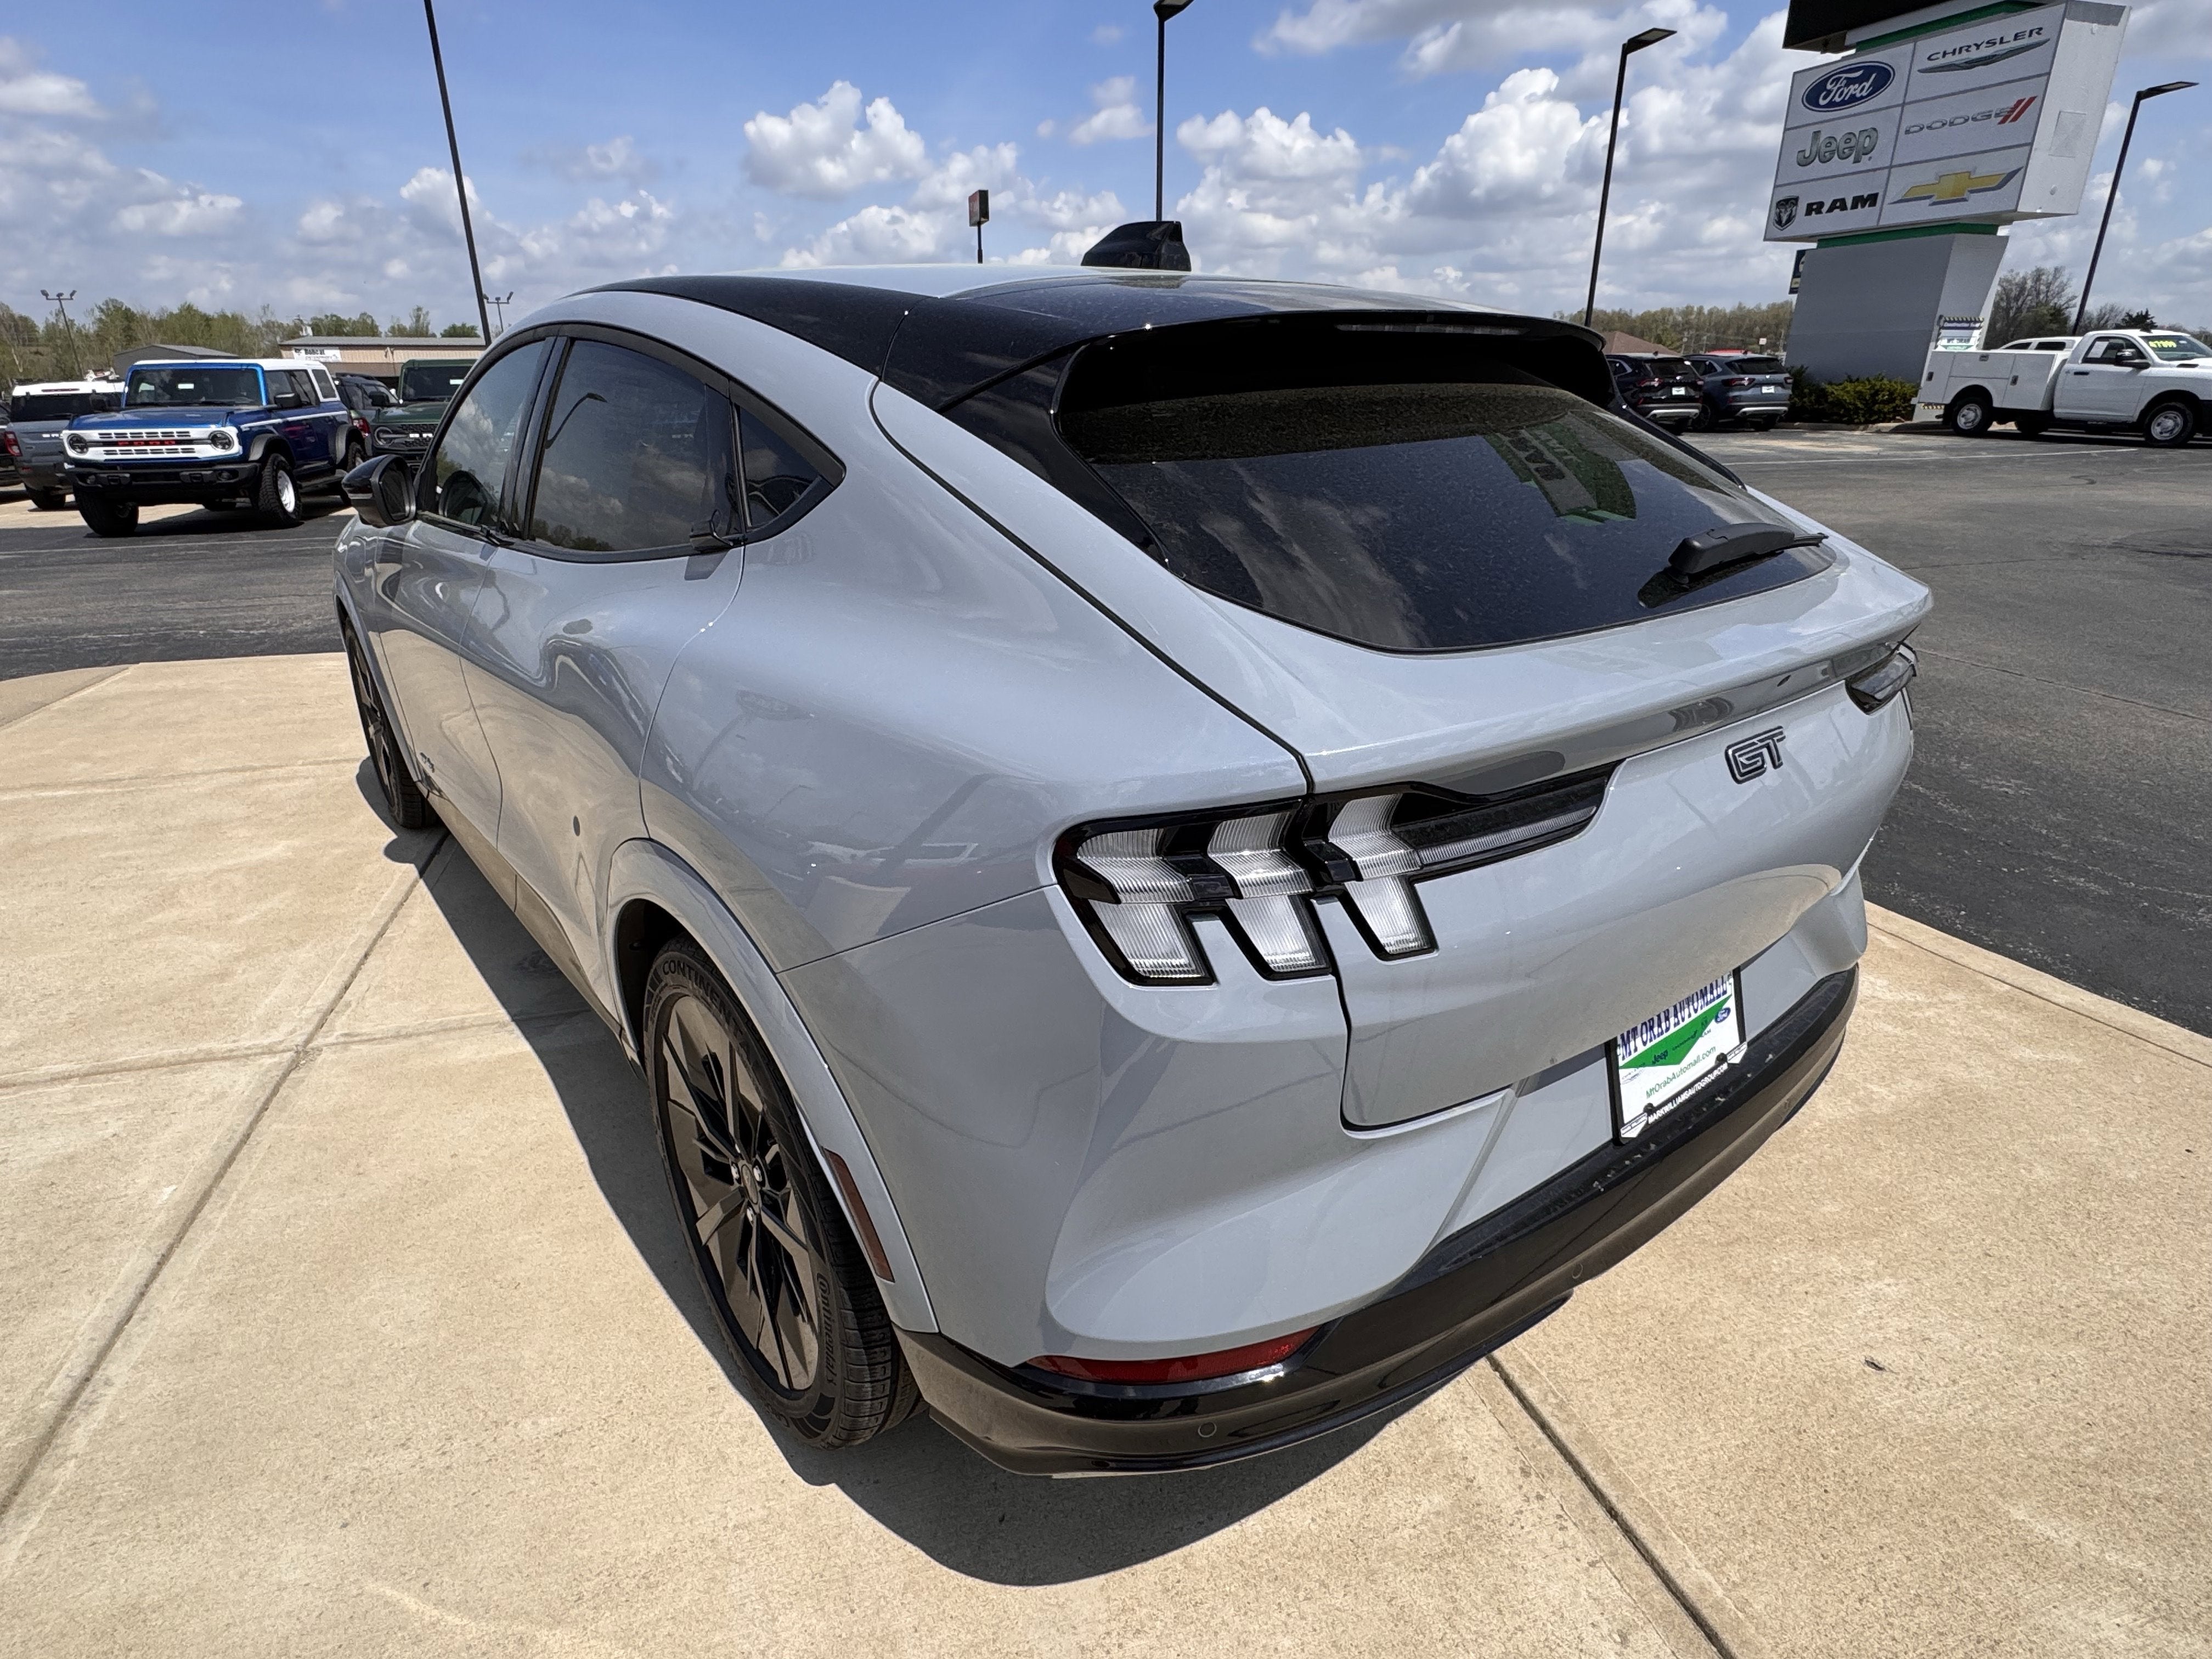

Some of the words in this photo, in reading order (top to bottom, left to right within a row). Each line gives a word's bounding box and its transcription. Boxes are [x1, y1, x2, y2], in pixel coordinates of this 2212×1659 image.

[1927, 27, 2044, 61] CHRYSLER
[1818, 70, 1877, 105] Ford
[1904, 106, 2016, 135] DODGE
[1796, 127, 1878, 167] Jeep
[1804, 192, 1879, 216] RAM
[1724, 725, 1786, 785] GT
[1620, 1026, 1639, 1061] MT
[1640, 1008, 1671, 1047] ORAB
[1673, 975, 1728, 1029] AUTOMALL
[817, 1273, 837, 1376] Continental
